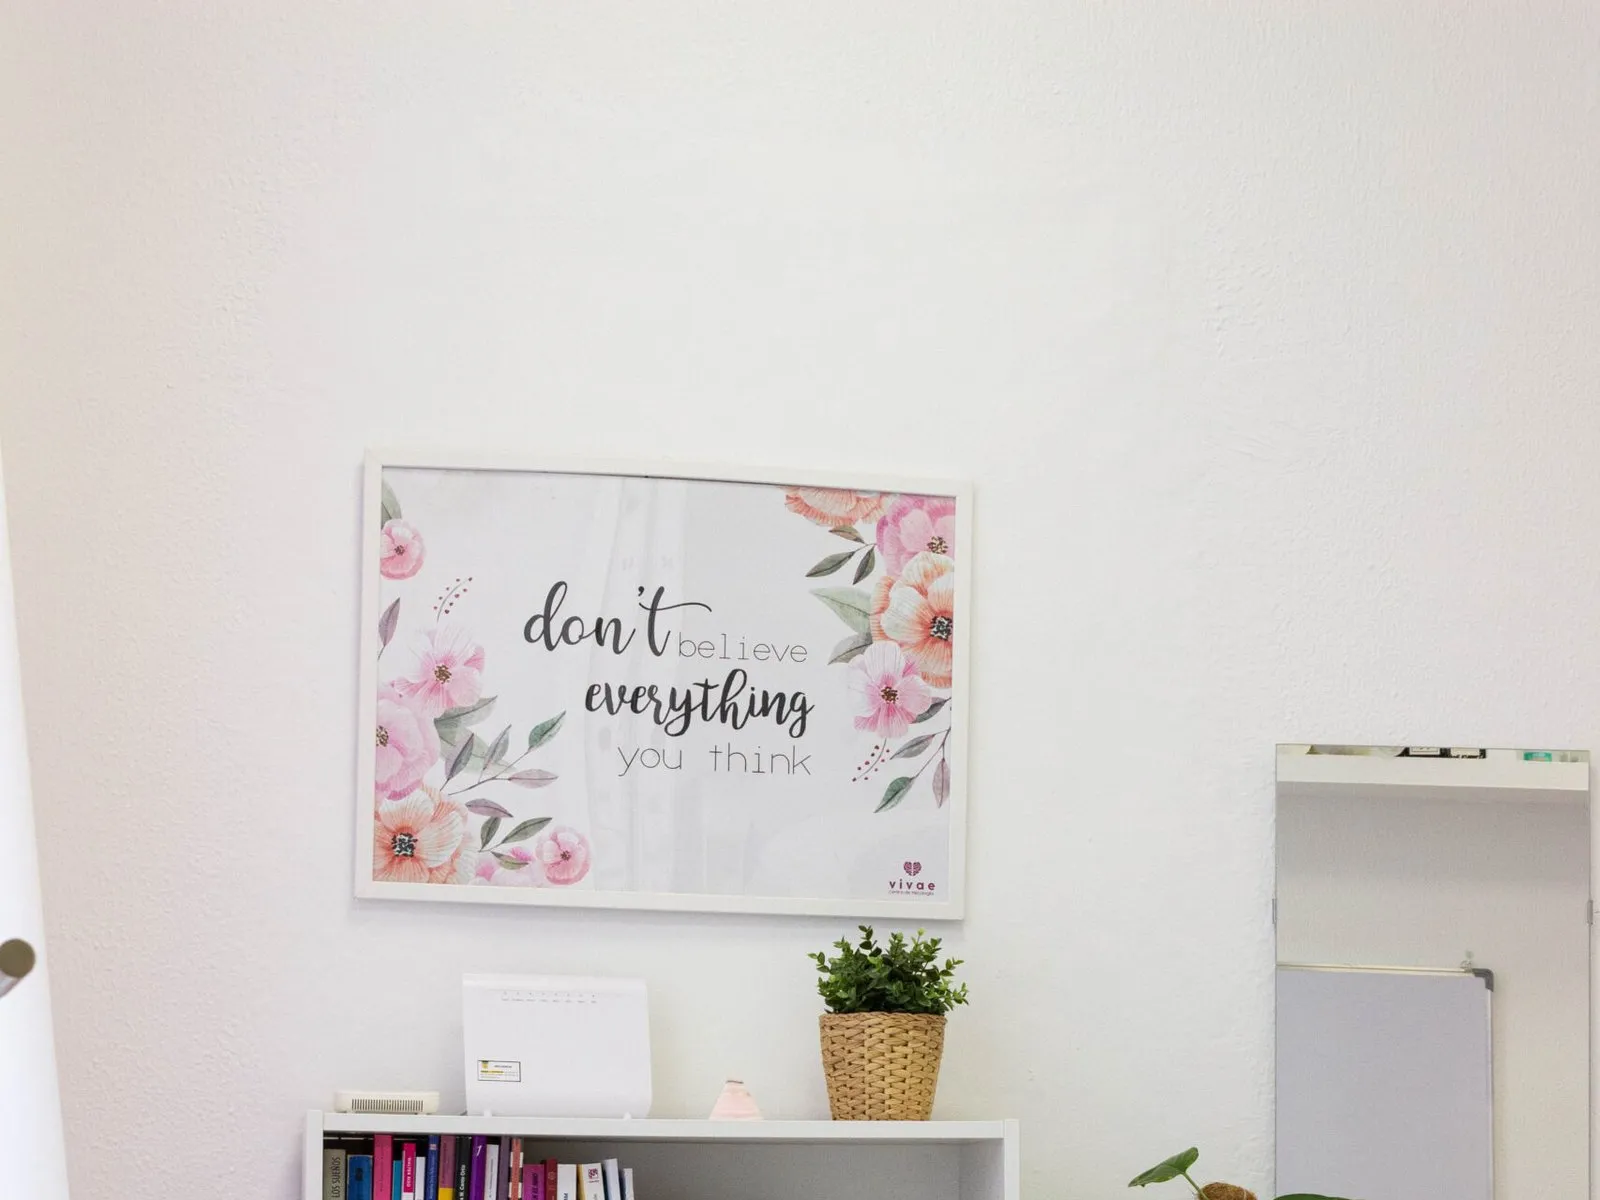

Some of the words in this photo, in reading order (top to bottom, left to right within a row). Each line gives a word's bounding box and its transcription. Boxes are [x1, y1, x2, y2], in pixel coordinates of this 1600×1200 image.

[524, 581, 712, 656] don't
[679, 632, 808, 662] believe
[585, 668, 815, 738] everything
[617, 747, 683, 777] you
[708, 742, 812, 776] think
[889, 879, 936, 891] vivae
[330, 1156, 341, 1184] SUEÑOS
[330, 1185, 341, 1198] LOS
